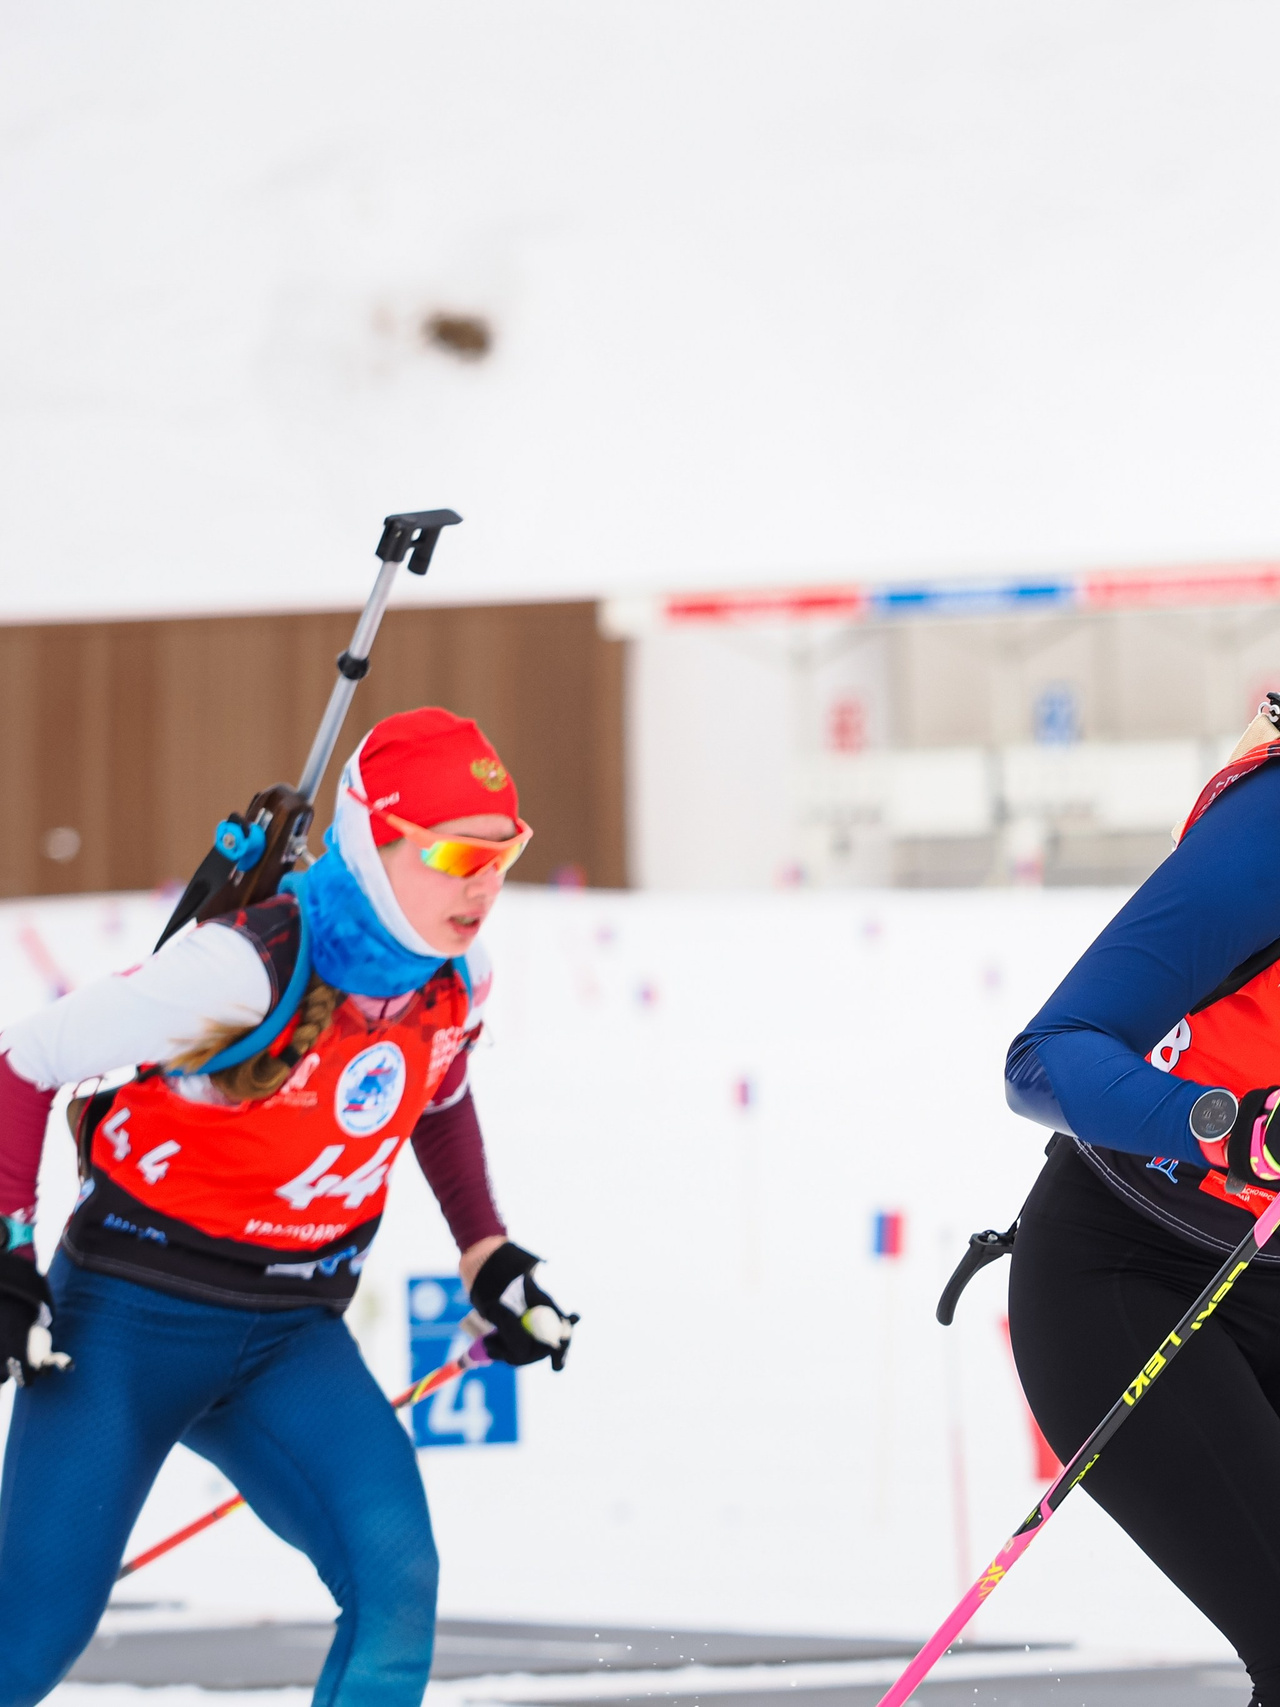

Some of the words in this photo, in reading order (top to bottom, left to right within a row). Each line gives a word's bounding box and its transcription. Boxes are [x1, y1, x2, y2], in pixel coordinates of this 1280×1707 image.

[274, 1135, 400, 1211] 44
[427, 1331, 494, 1444] 4
[1122, 1330, 1183, 1407] LEKI
